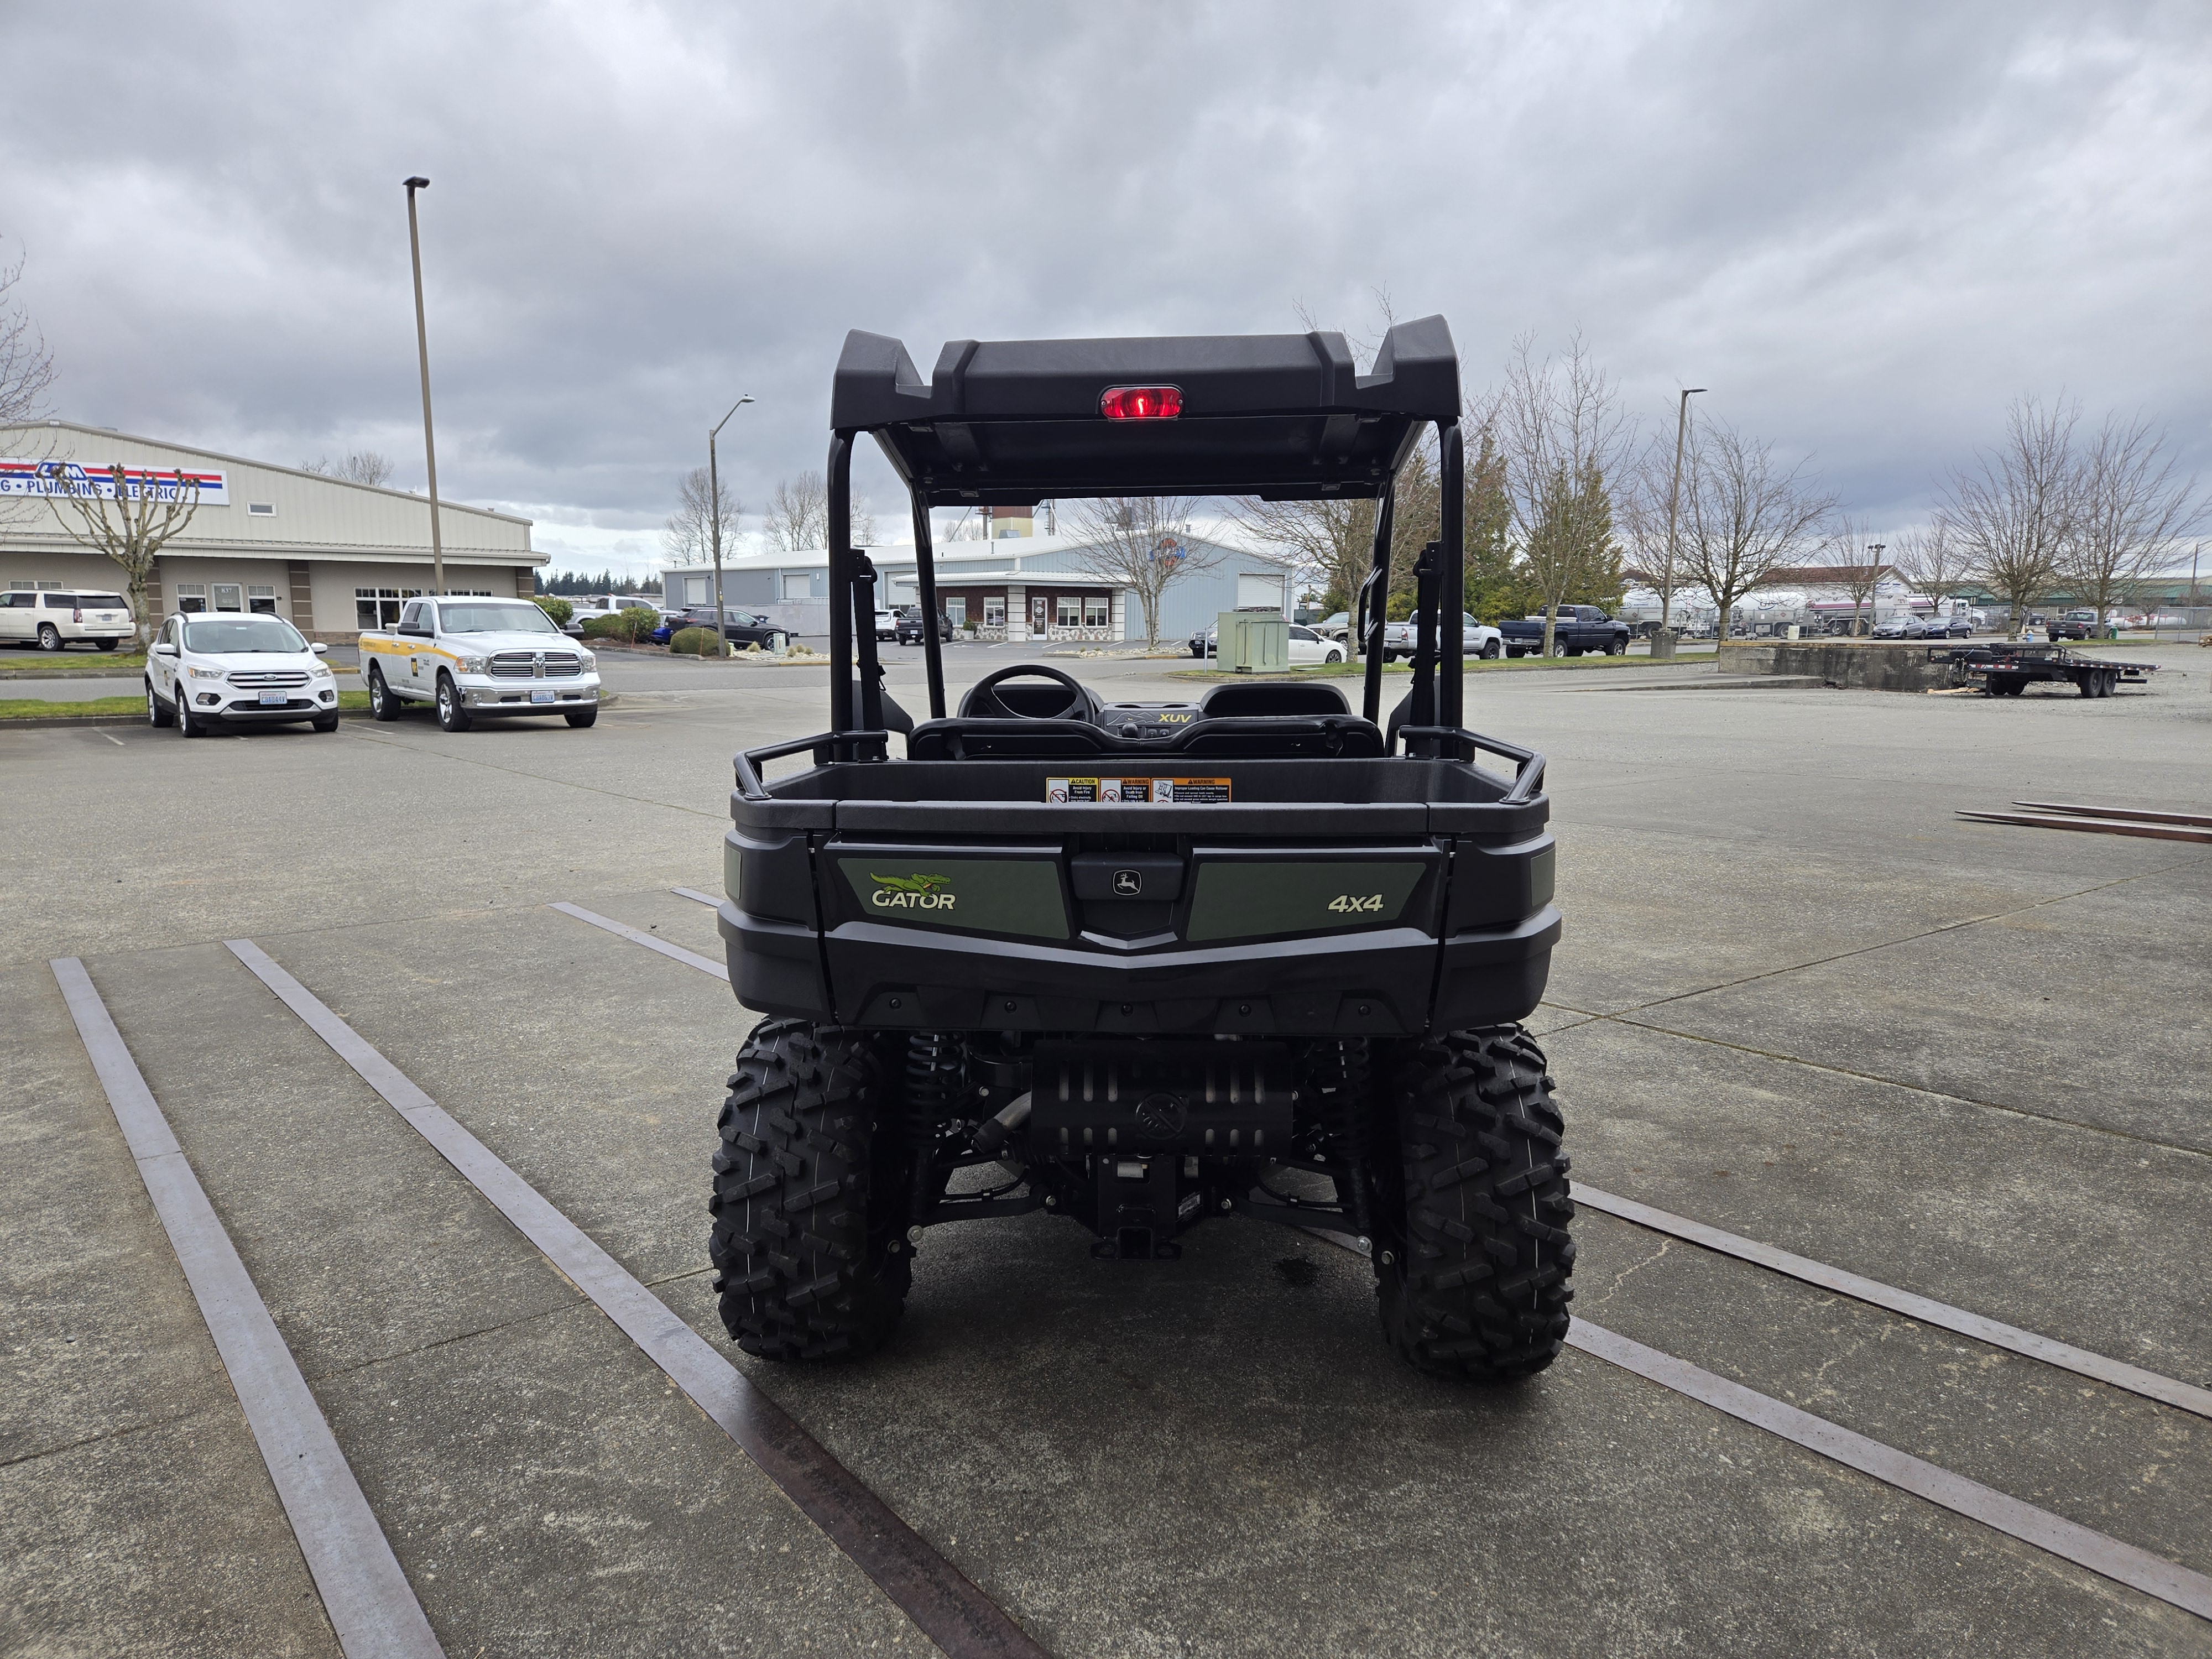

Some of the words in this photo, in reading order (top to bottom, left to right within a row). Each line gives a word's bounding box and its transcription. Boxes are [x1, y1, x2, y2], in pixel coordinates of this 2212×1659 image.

[28, 481, 102, 495] PLUMBING
[1159, 713, 1192, 723] XUV
[872, 890, 956, 910] GATOR
[1328, 894, 1384, 912] 4x4
